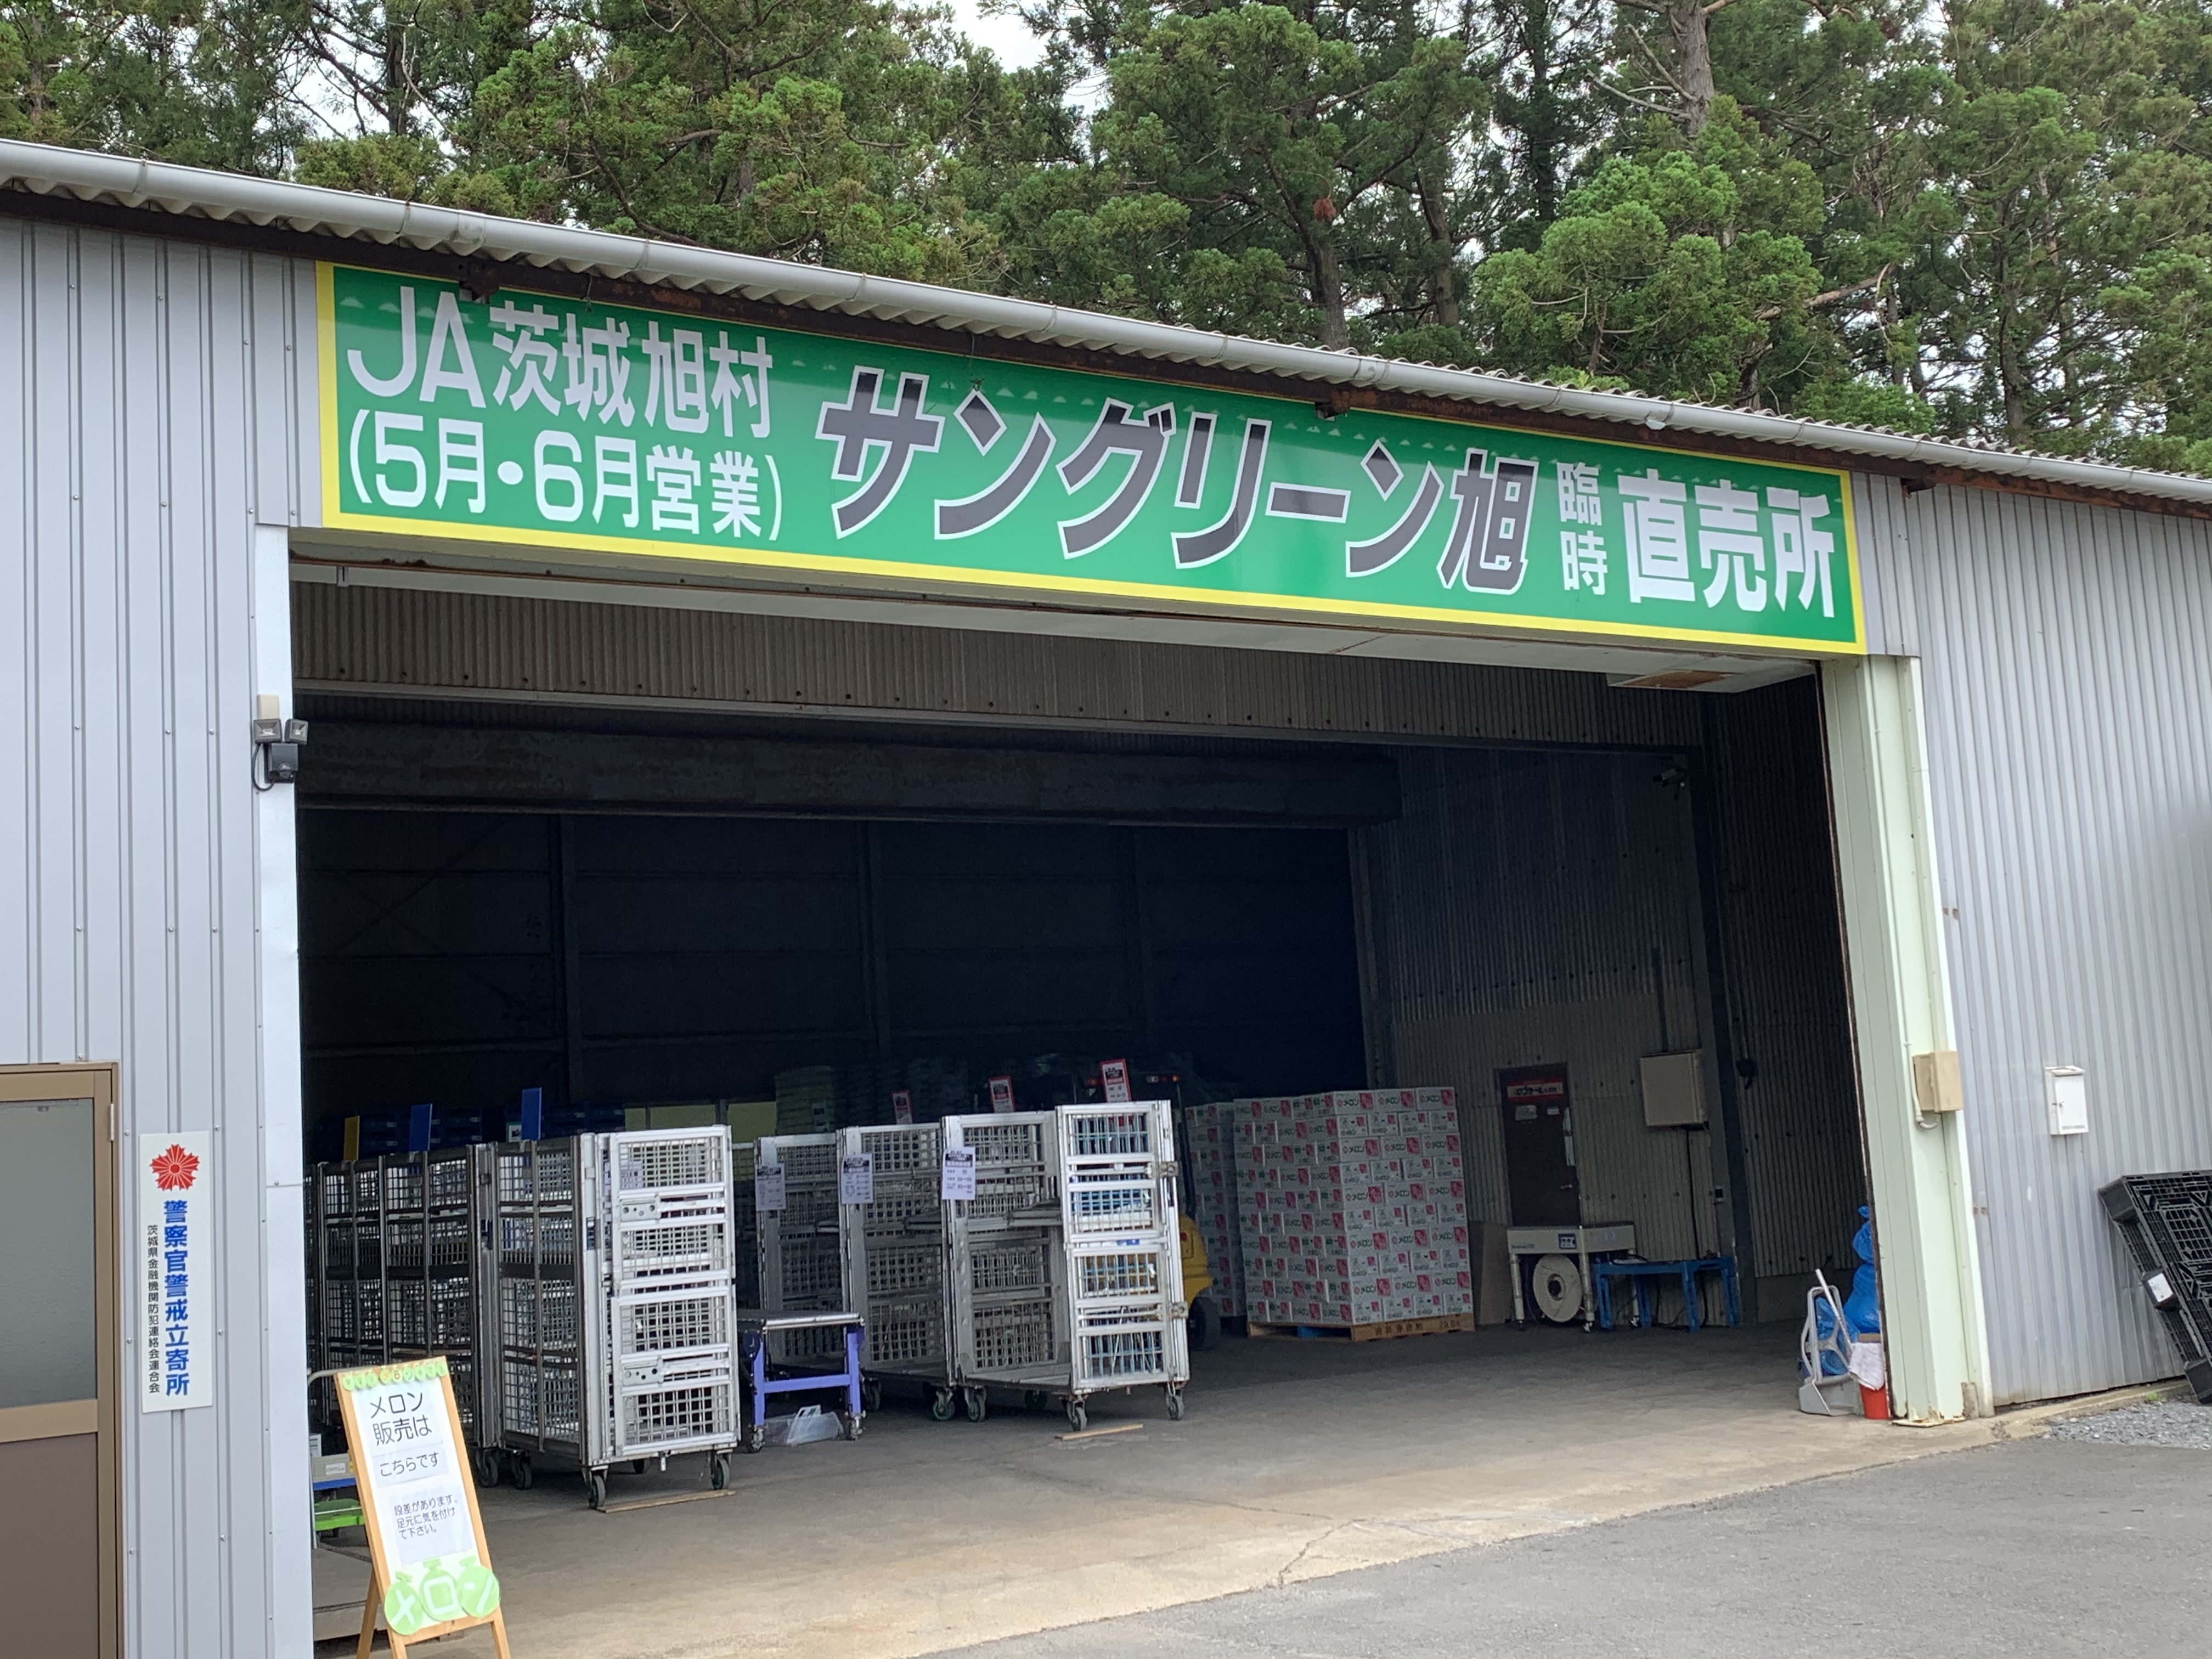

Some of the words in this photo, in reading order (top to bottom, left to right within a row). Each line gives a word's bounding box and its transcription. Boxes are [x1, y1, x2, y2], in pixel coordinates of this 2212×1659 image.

[347, 285, 772, 438] JA茨城旭村
[815, 365, 1539, 595] サングリーン旭
[1556, 462, 1607, 595] 臨時
[1617, 468, 1834, 618] 直売所
[147, 1224, 160, 1393] 茨城県金融機関防犯連絡会連合会
[164, 1200, 189, 1397] 警察官警戒立寄所
[370, 1392, 423, 1419] メロン
[373, 1414, 432, 1446] 販売は
[380, 1452, 439, 1476] こちらです
[397, 1506, 455, 1529] 足元に気を付け
[398, 1523, 437, 1539] て下さい。
[391, 1573, 493, 1626] メロン
